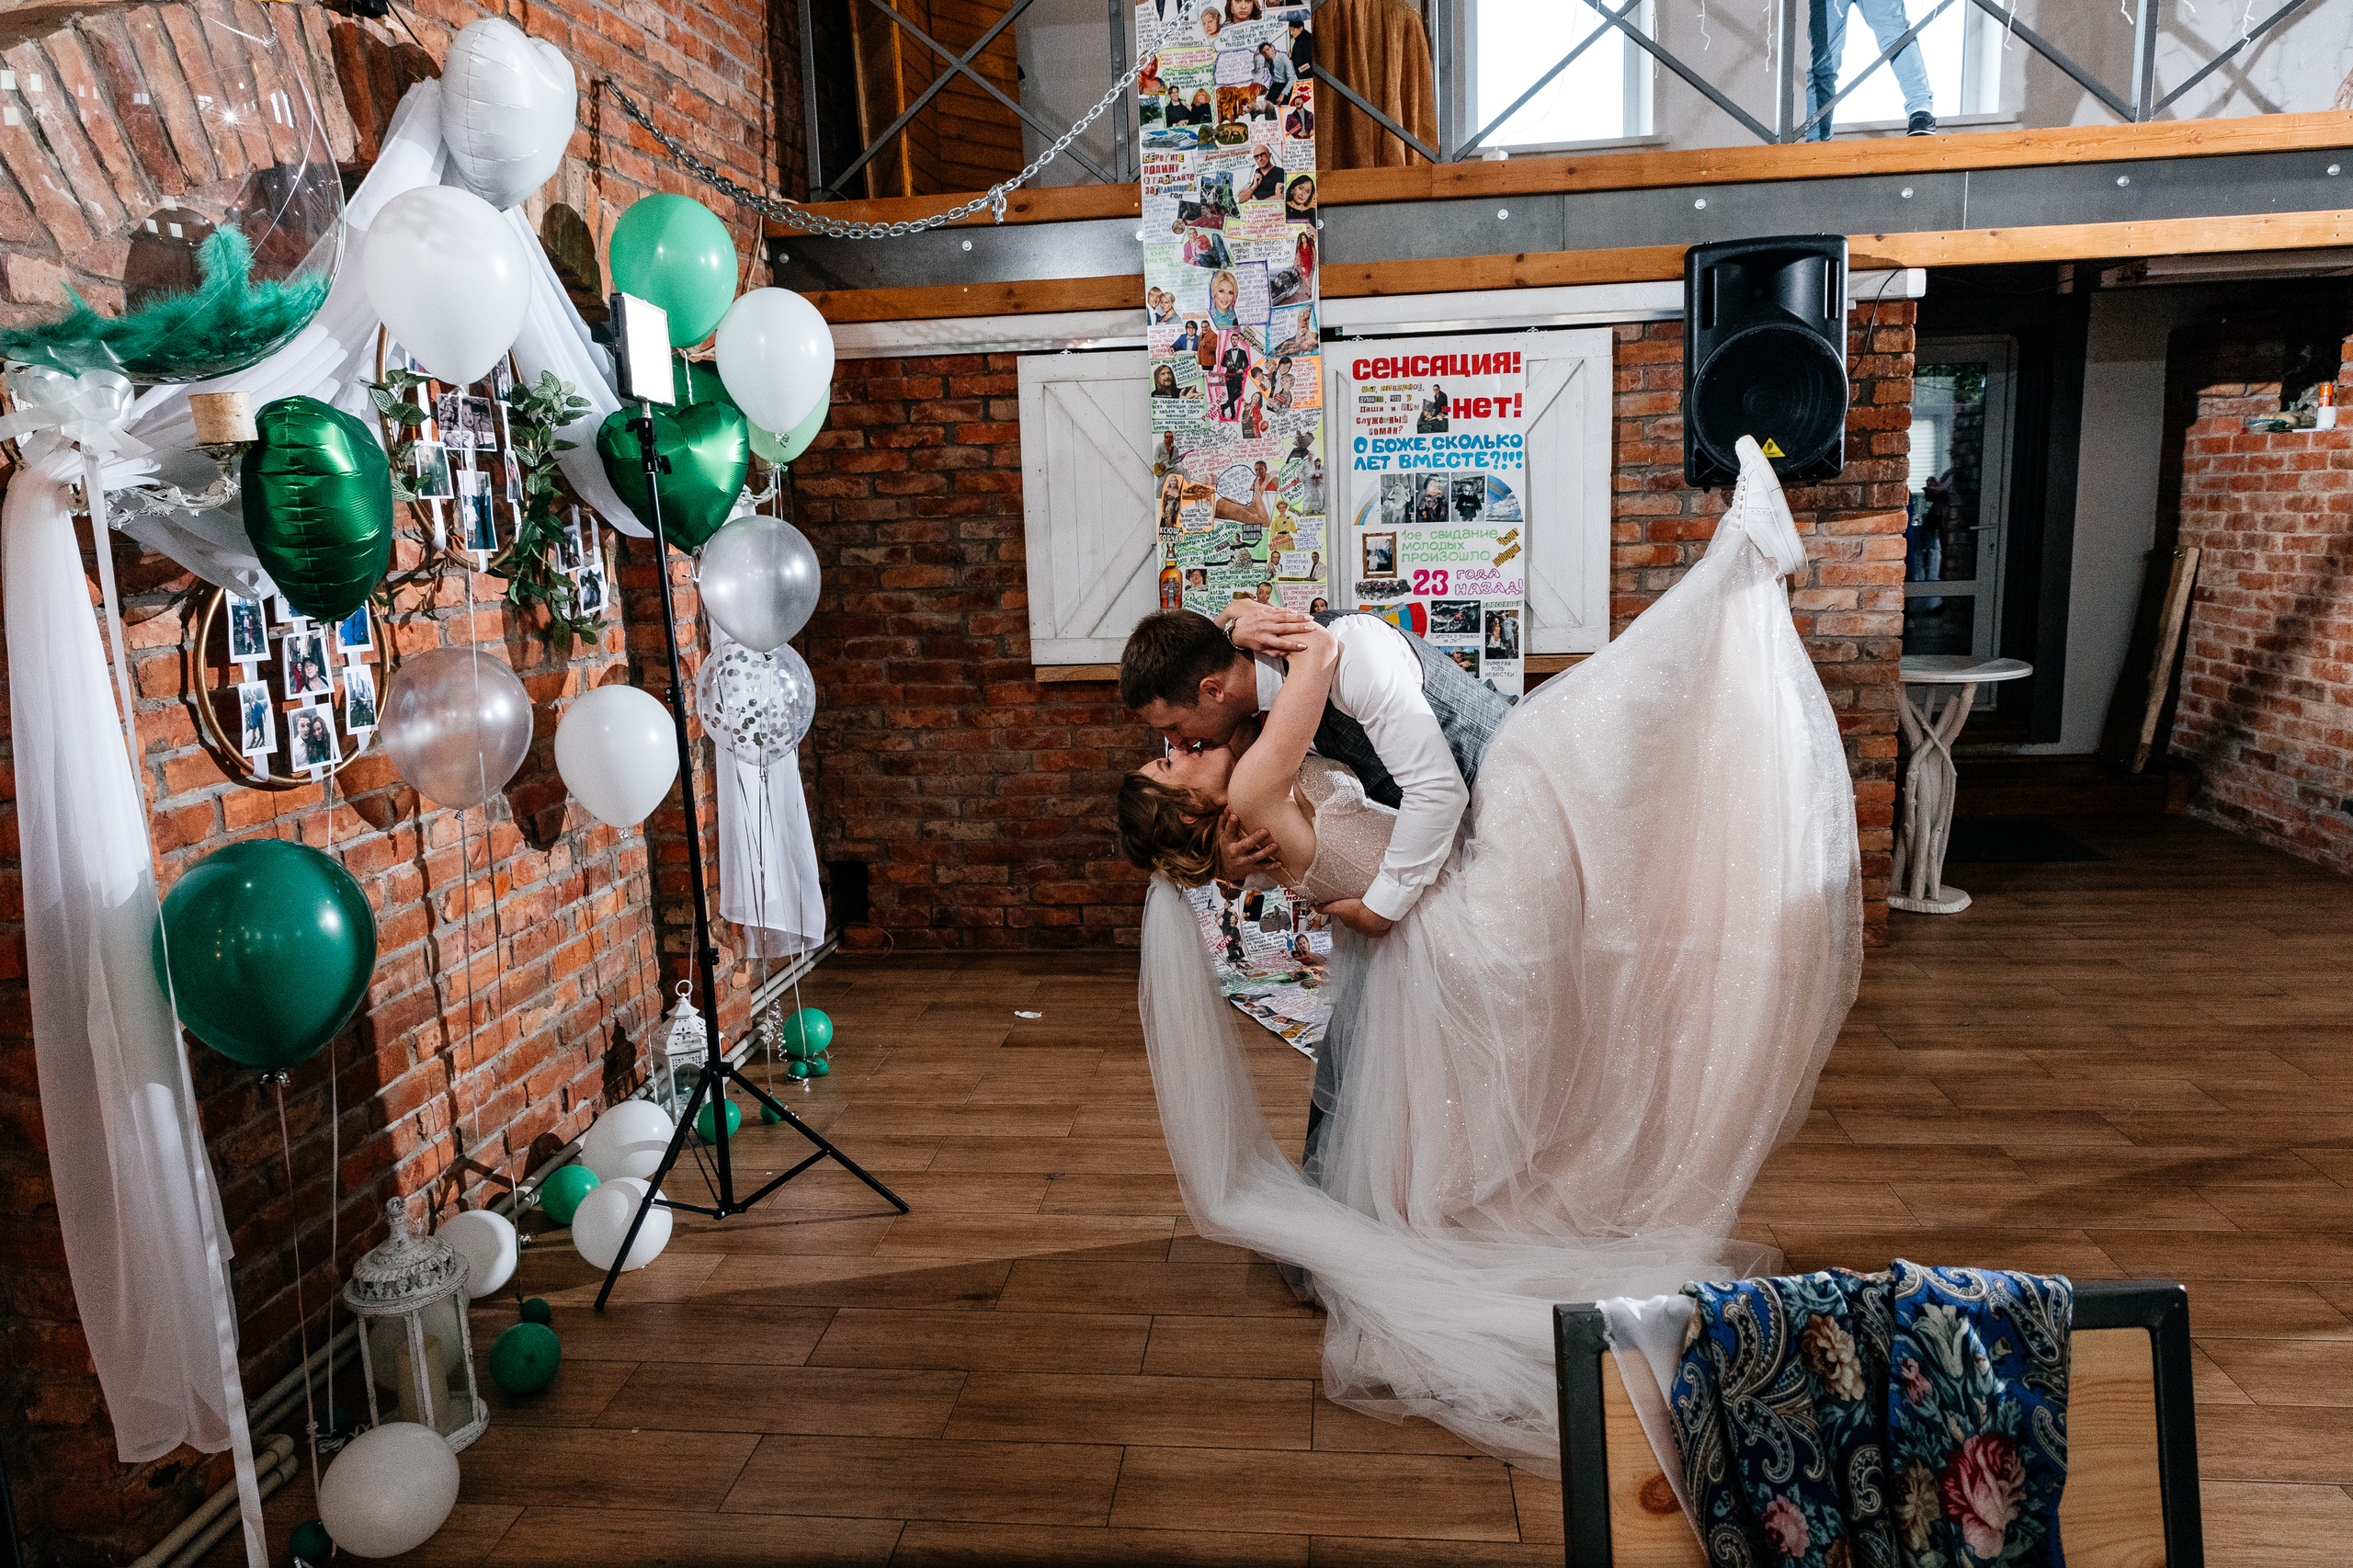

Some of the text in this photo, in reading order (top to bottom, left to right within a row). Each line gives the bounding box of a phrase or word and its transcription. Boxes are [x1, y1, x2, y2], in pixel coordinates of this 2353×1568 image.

[1354, 434, 1523, 453] О БОЖЕ, СКОЛЬКО
[1354, 455, 1391, 471] ЛЕТ
[1430, 529, 1498, 540] свидание
[1413, 568, 1501, 596] 23 ГОДА
[1218, 935, 1233, 950] LOVE
